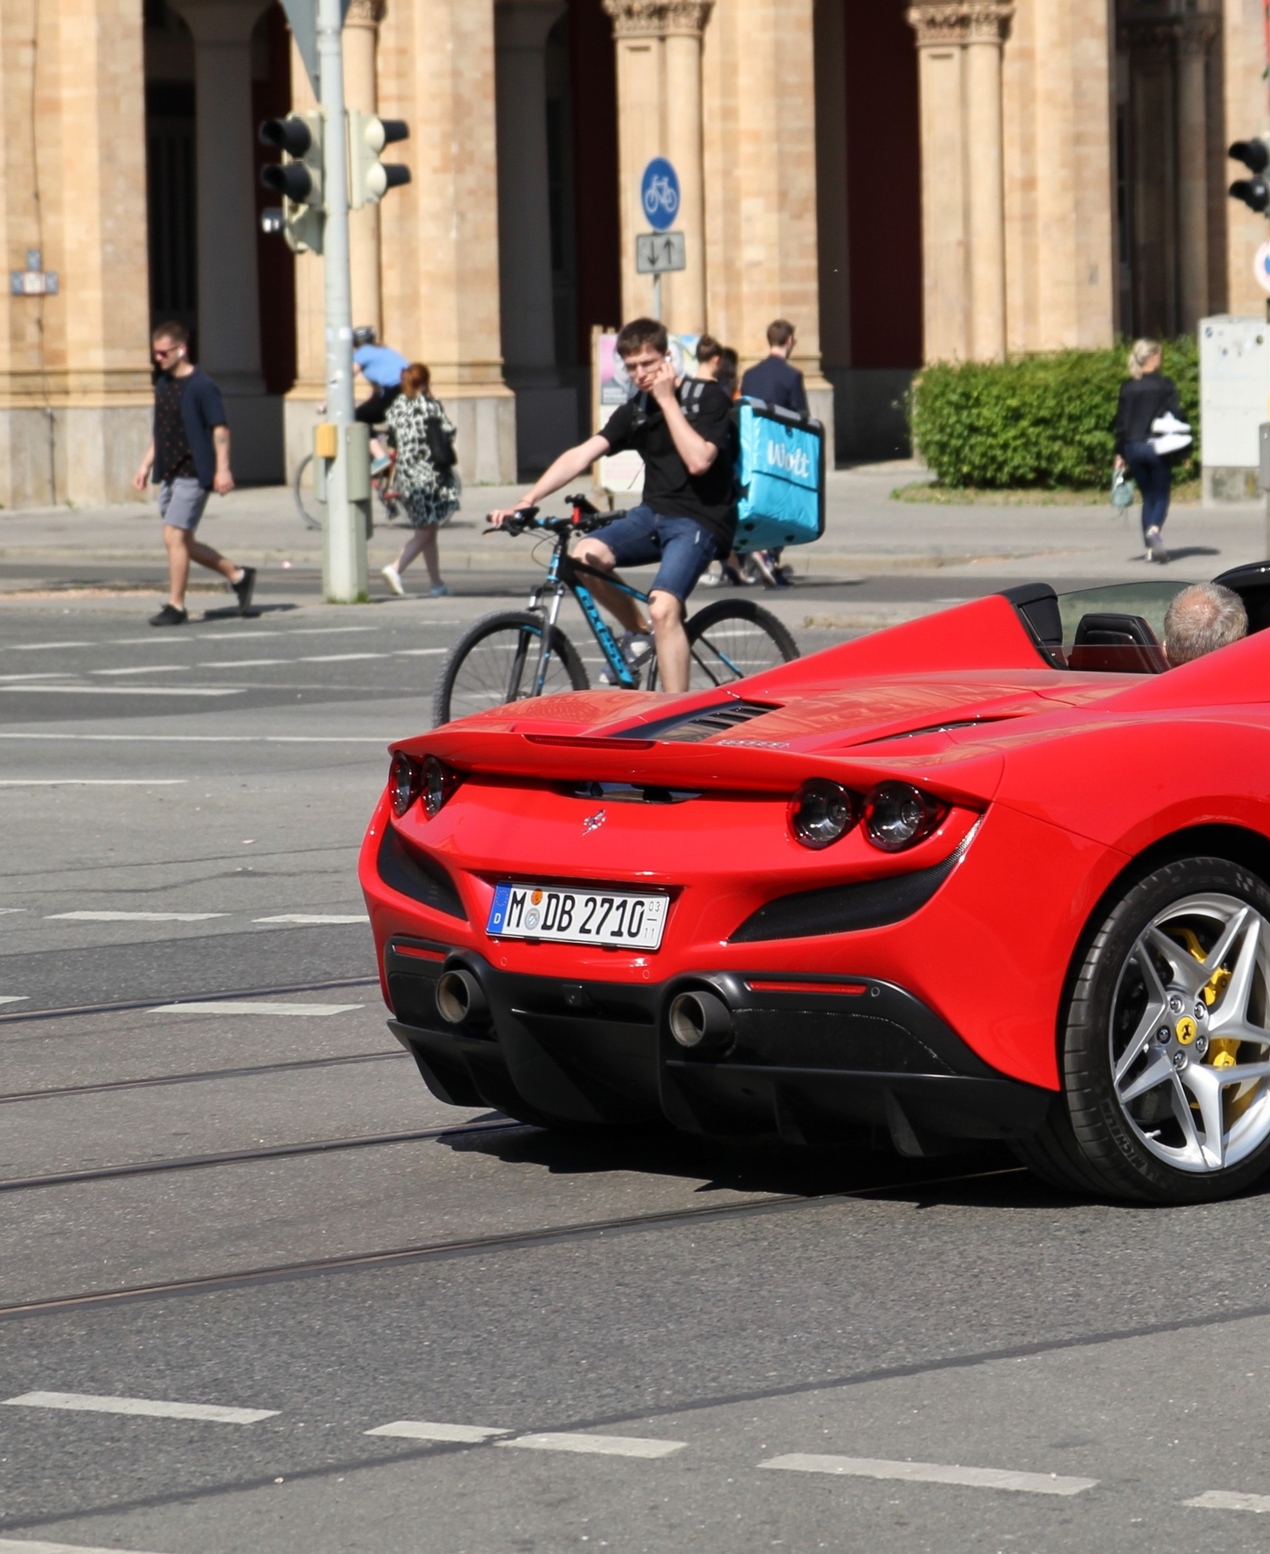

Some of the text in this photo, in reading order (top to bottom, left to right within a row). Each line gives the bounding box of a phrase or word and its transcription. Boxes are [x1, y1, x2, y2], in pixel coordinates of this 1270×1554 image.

[767, 439, 809, 478] Wolt
[648, 901, 661, 912] 03
[493, 913, 501, 925] D
[506, 890, 645, 938] M DB 2710
[644, 927, 655, 939] 11
